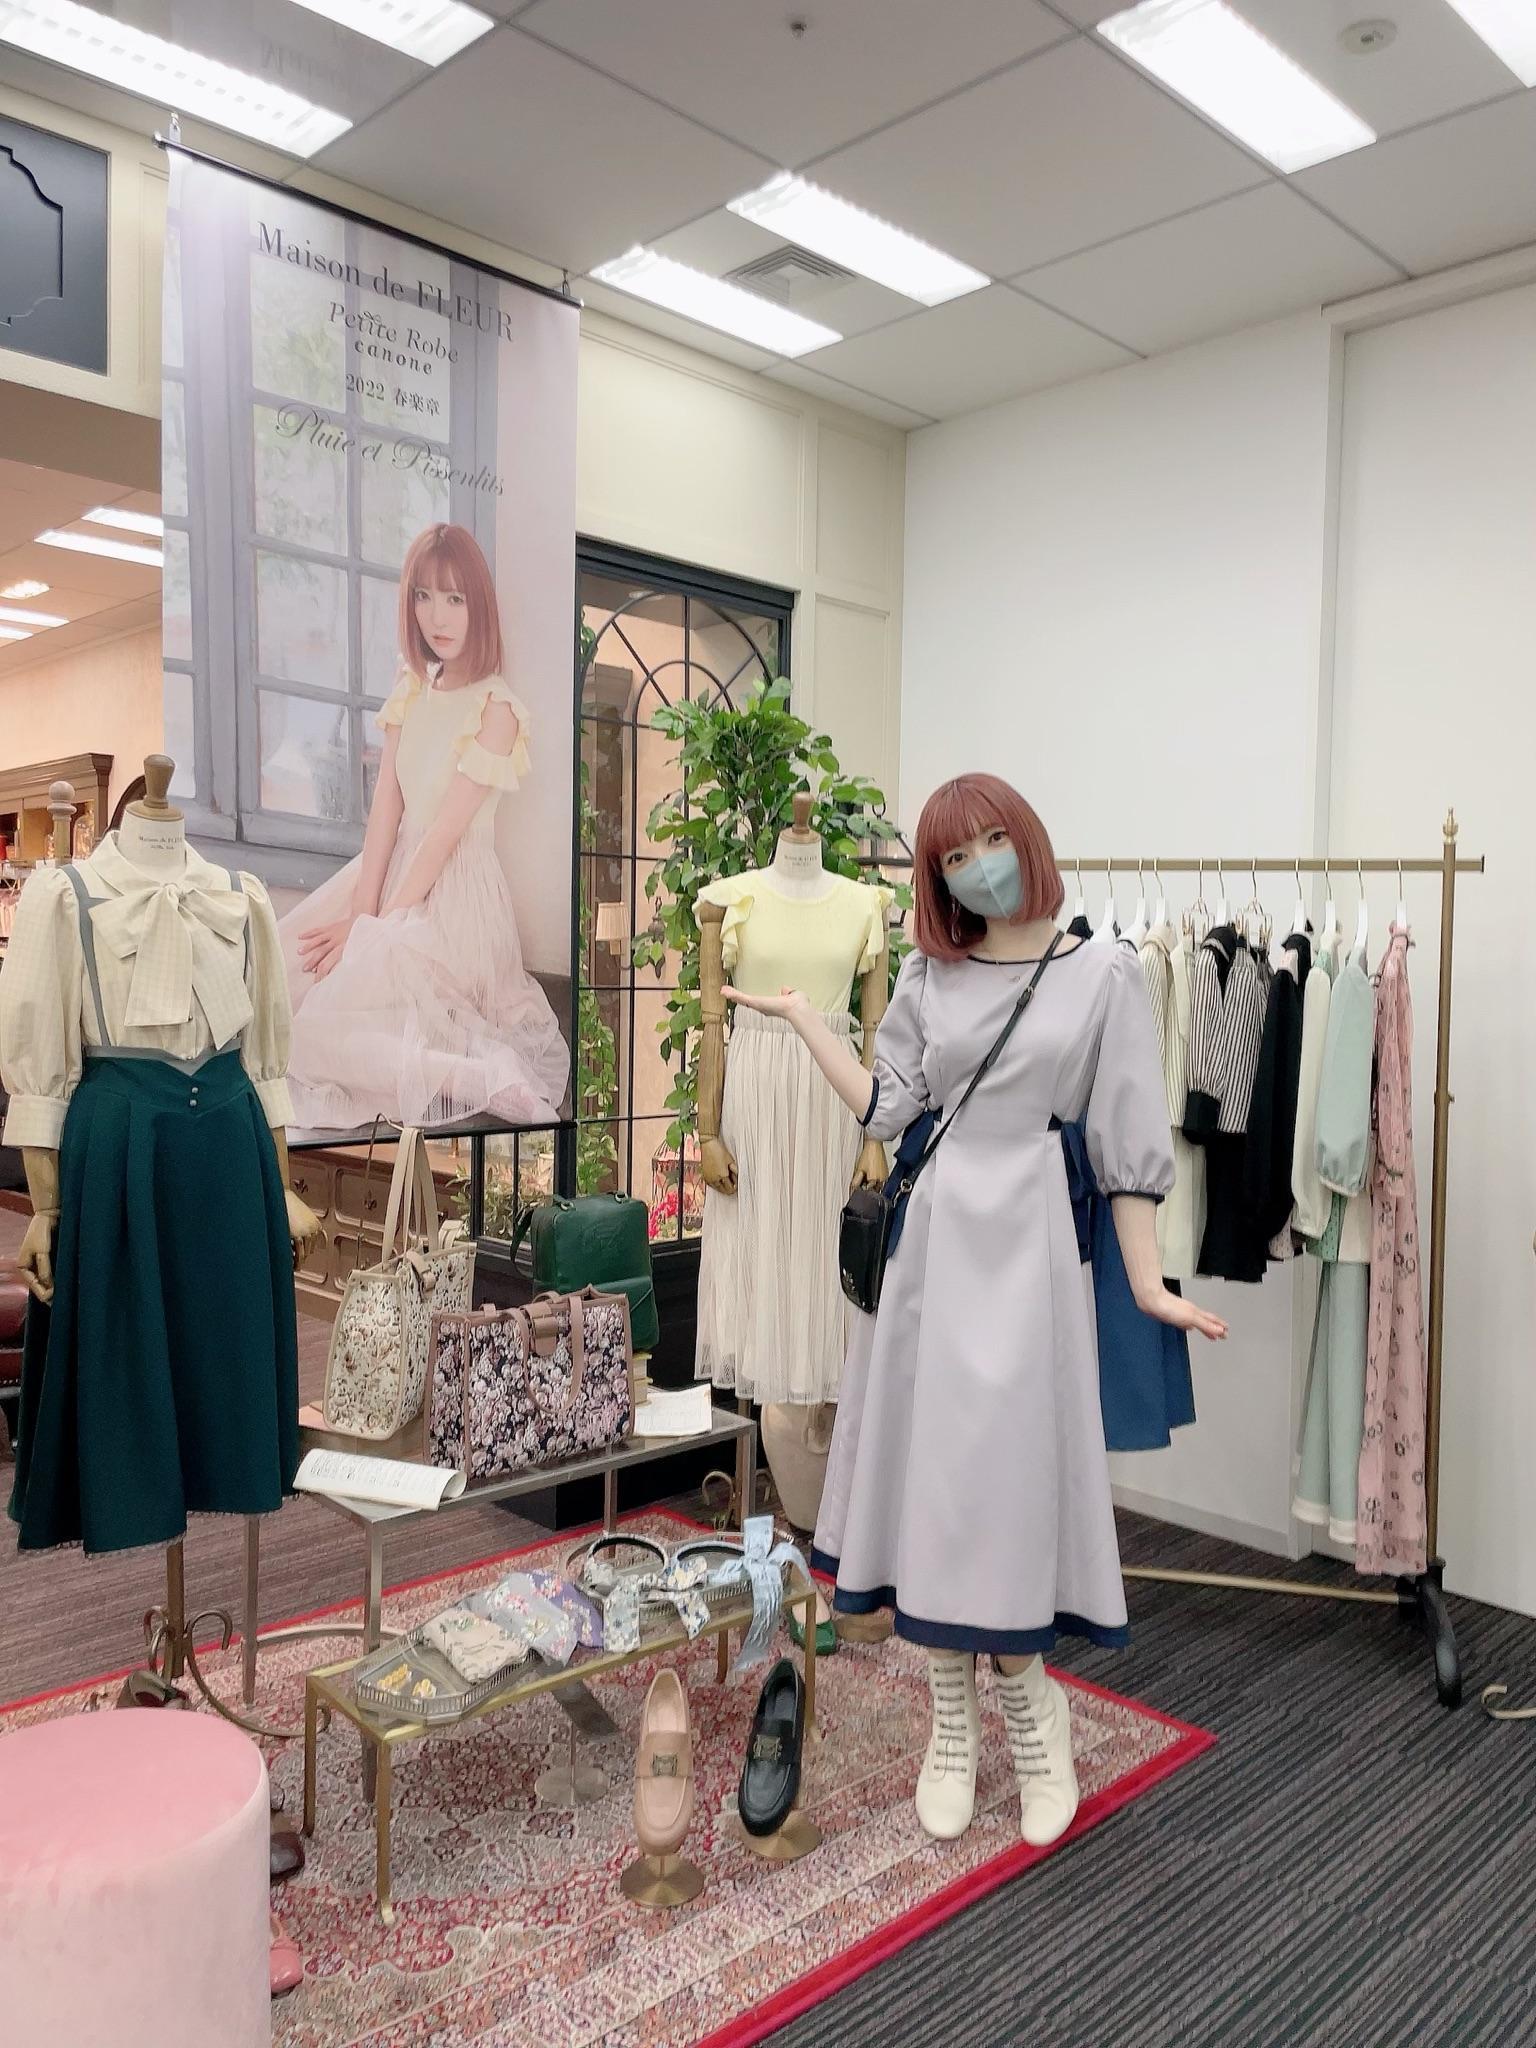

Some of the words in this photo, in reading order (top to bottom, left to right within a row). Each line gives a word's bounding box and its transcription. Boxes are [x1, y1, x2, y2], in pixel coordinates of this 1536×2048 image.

[257, 220, 361, 287] Maison
[373, 265, 404, 301] de
[418, 279, 512, 342] FLEUR
[330, 302, 397, 343] Petite
[407, 328, 459, 363] Robe
[354, 340, 432, 375] canone
[346, 373, 385, 401] 2022
[275, 403, 356, 453] Pluie
[362, 443, 383, 461] et
[392, 436, 504, 497] Pissenlits
